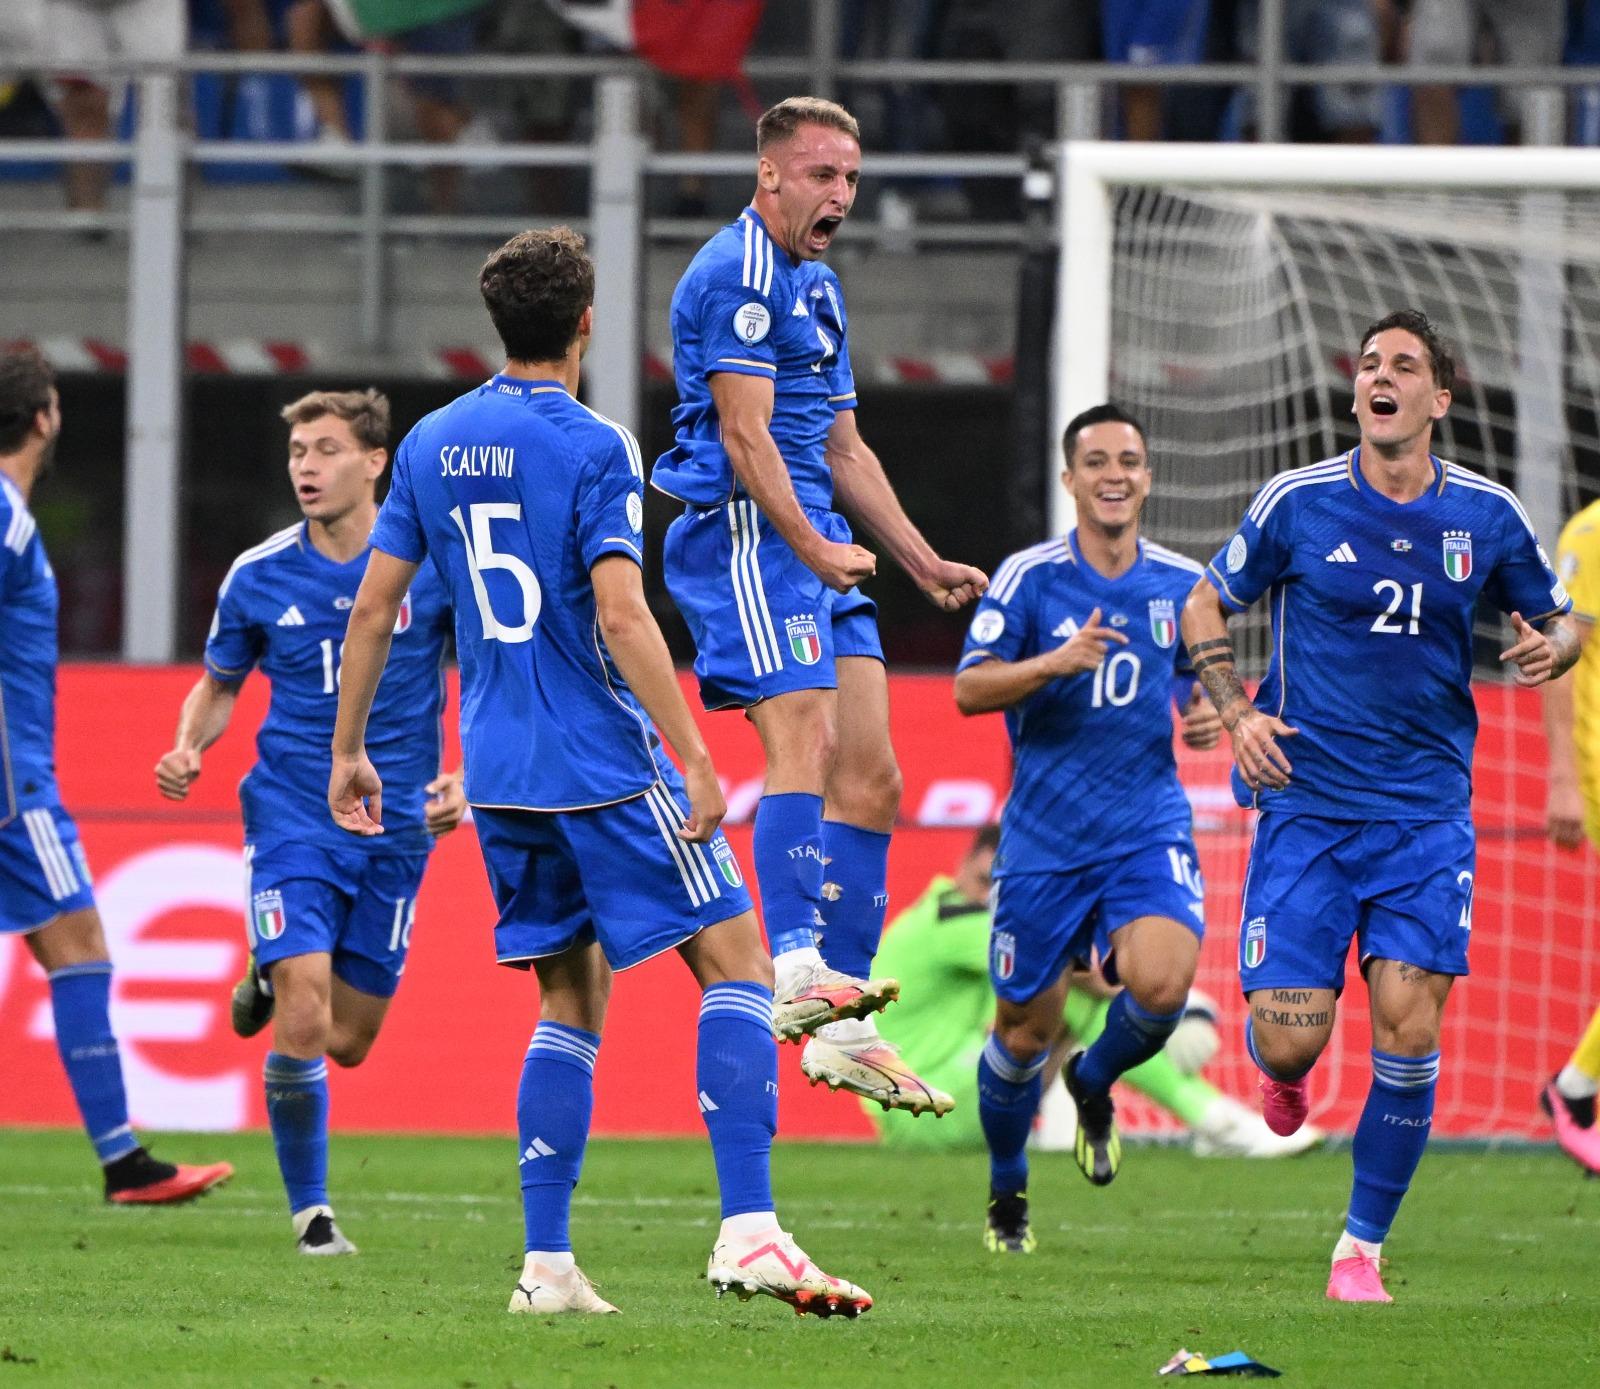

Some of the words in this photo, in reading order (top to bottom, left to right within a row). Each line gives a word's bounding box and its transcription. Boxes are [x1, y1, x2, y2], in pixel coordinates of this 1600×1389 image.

[497, 383, 522, 397] ITALIA
[440, 445, 515, 478] SCALVINI
[1445, 541, 1469, 551] ITALIA
[449, 502, 542, 643] 15
[1370, 579, 1423, 635] 21
[789, 623, 815, 637] ITALIA
[319, 638, 346, 694] 1
[1091, 651, 1141, 708] 10
[1457, 870, 1475, 931] 2
[1271, 989, 1312, 1005] MMIV
